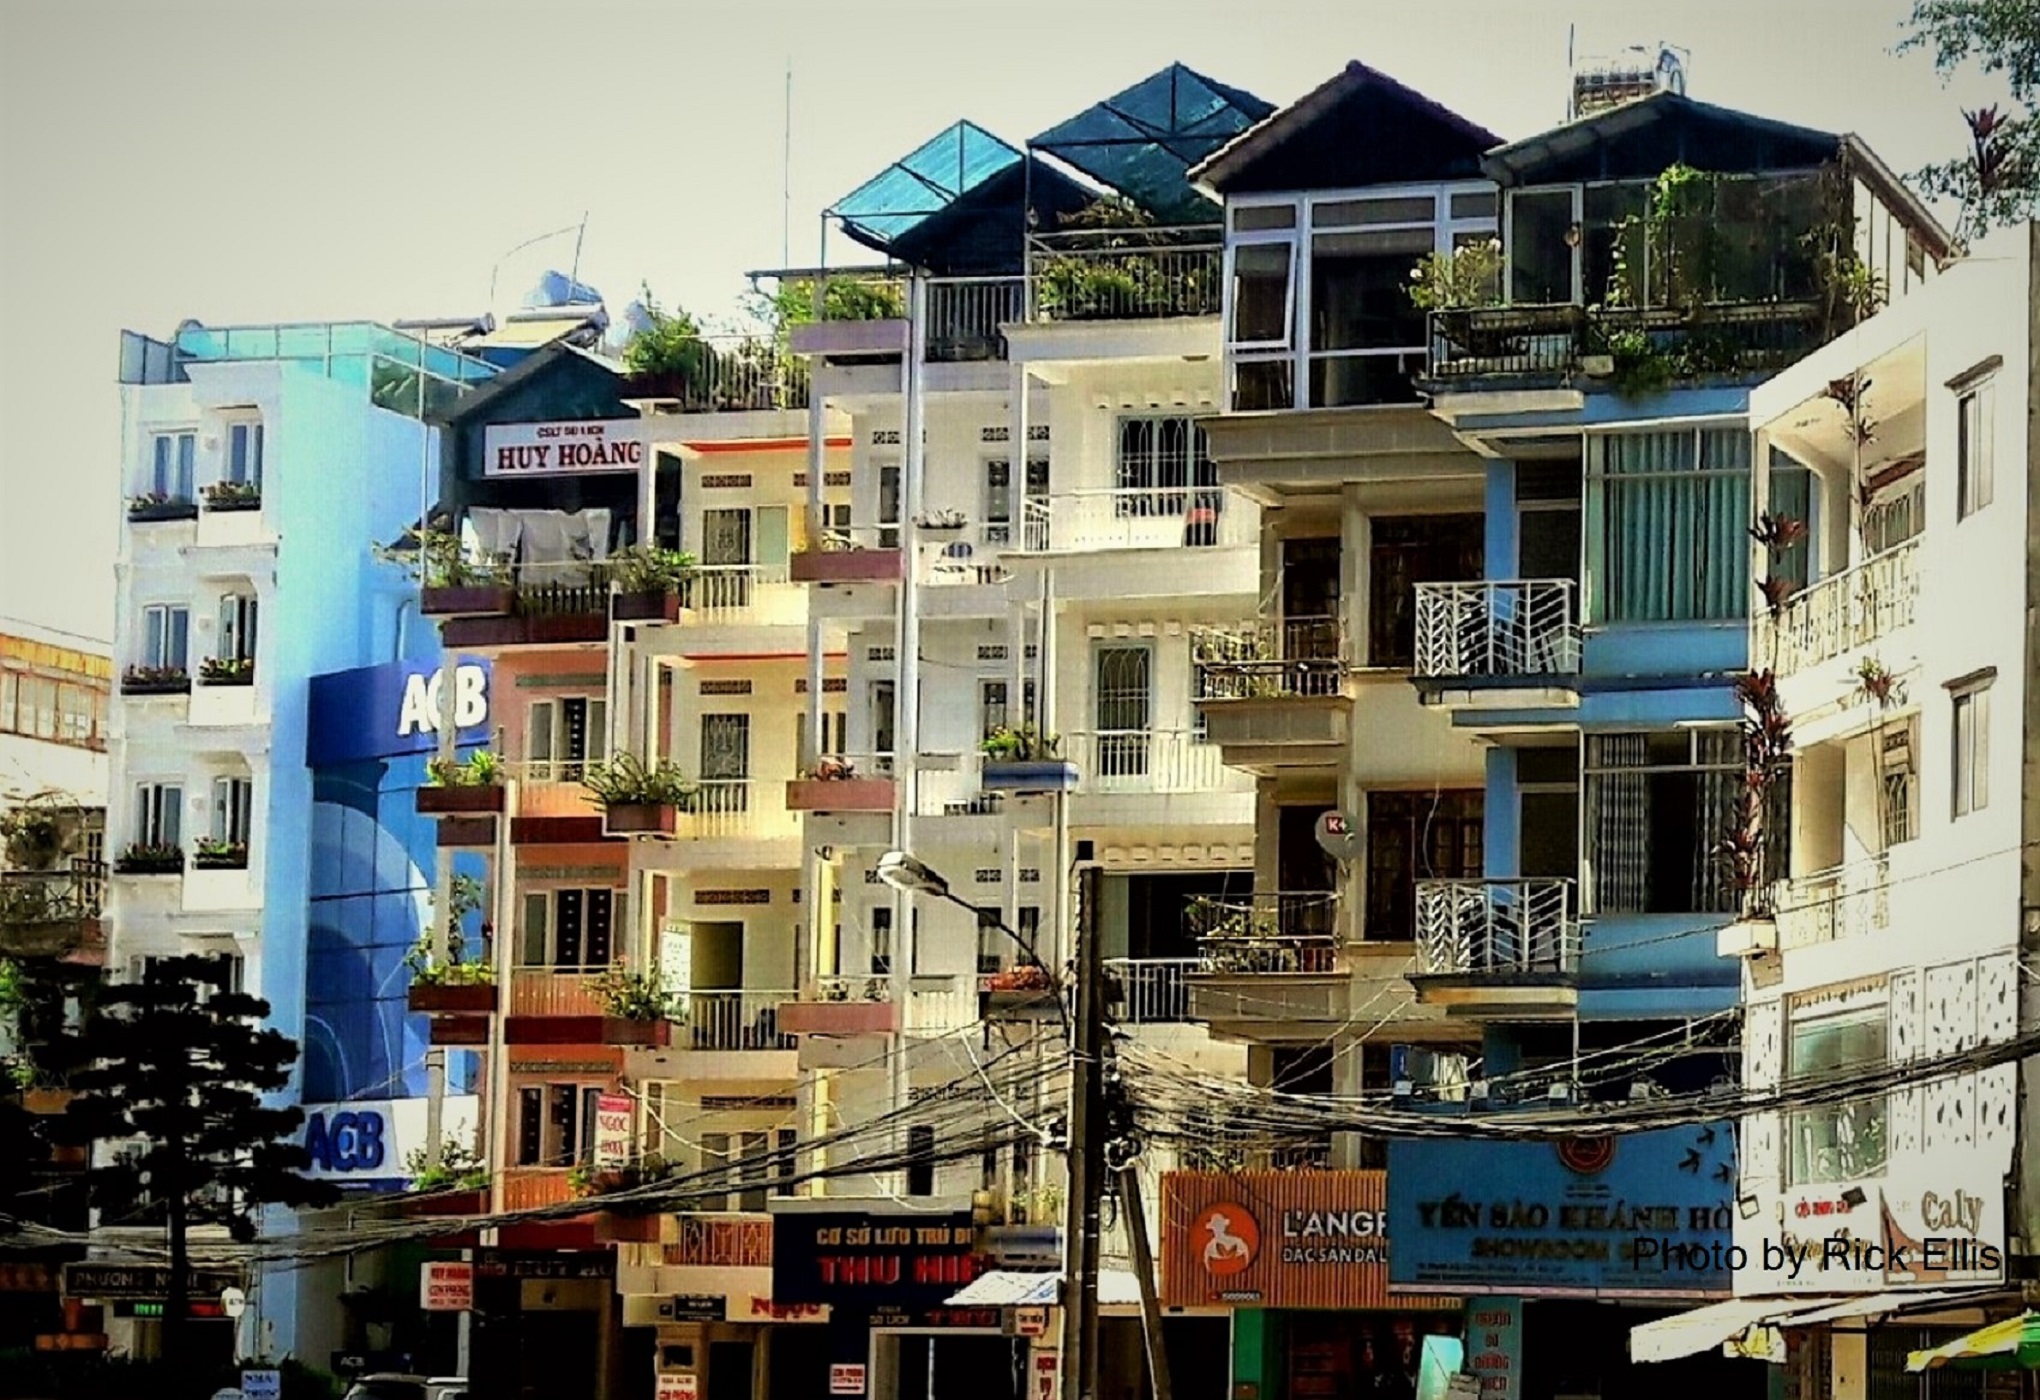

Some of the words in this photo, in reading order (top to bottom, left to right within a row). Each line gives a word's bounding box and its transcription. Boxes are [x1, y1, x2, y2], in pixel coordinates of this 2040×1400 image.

[497, 444, 549, 469] HUY
[558, 438, 641, 467] HOÀNG
[304, 1110, 385, 1172] ACB
[1921, 1189, 1984, 1236] Caly
[817, 1256, 900, 1284] THU
[341, 1357, 365, 1366] ACB
